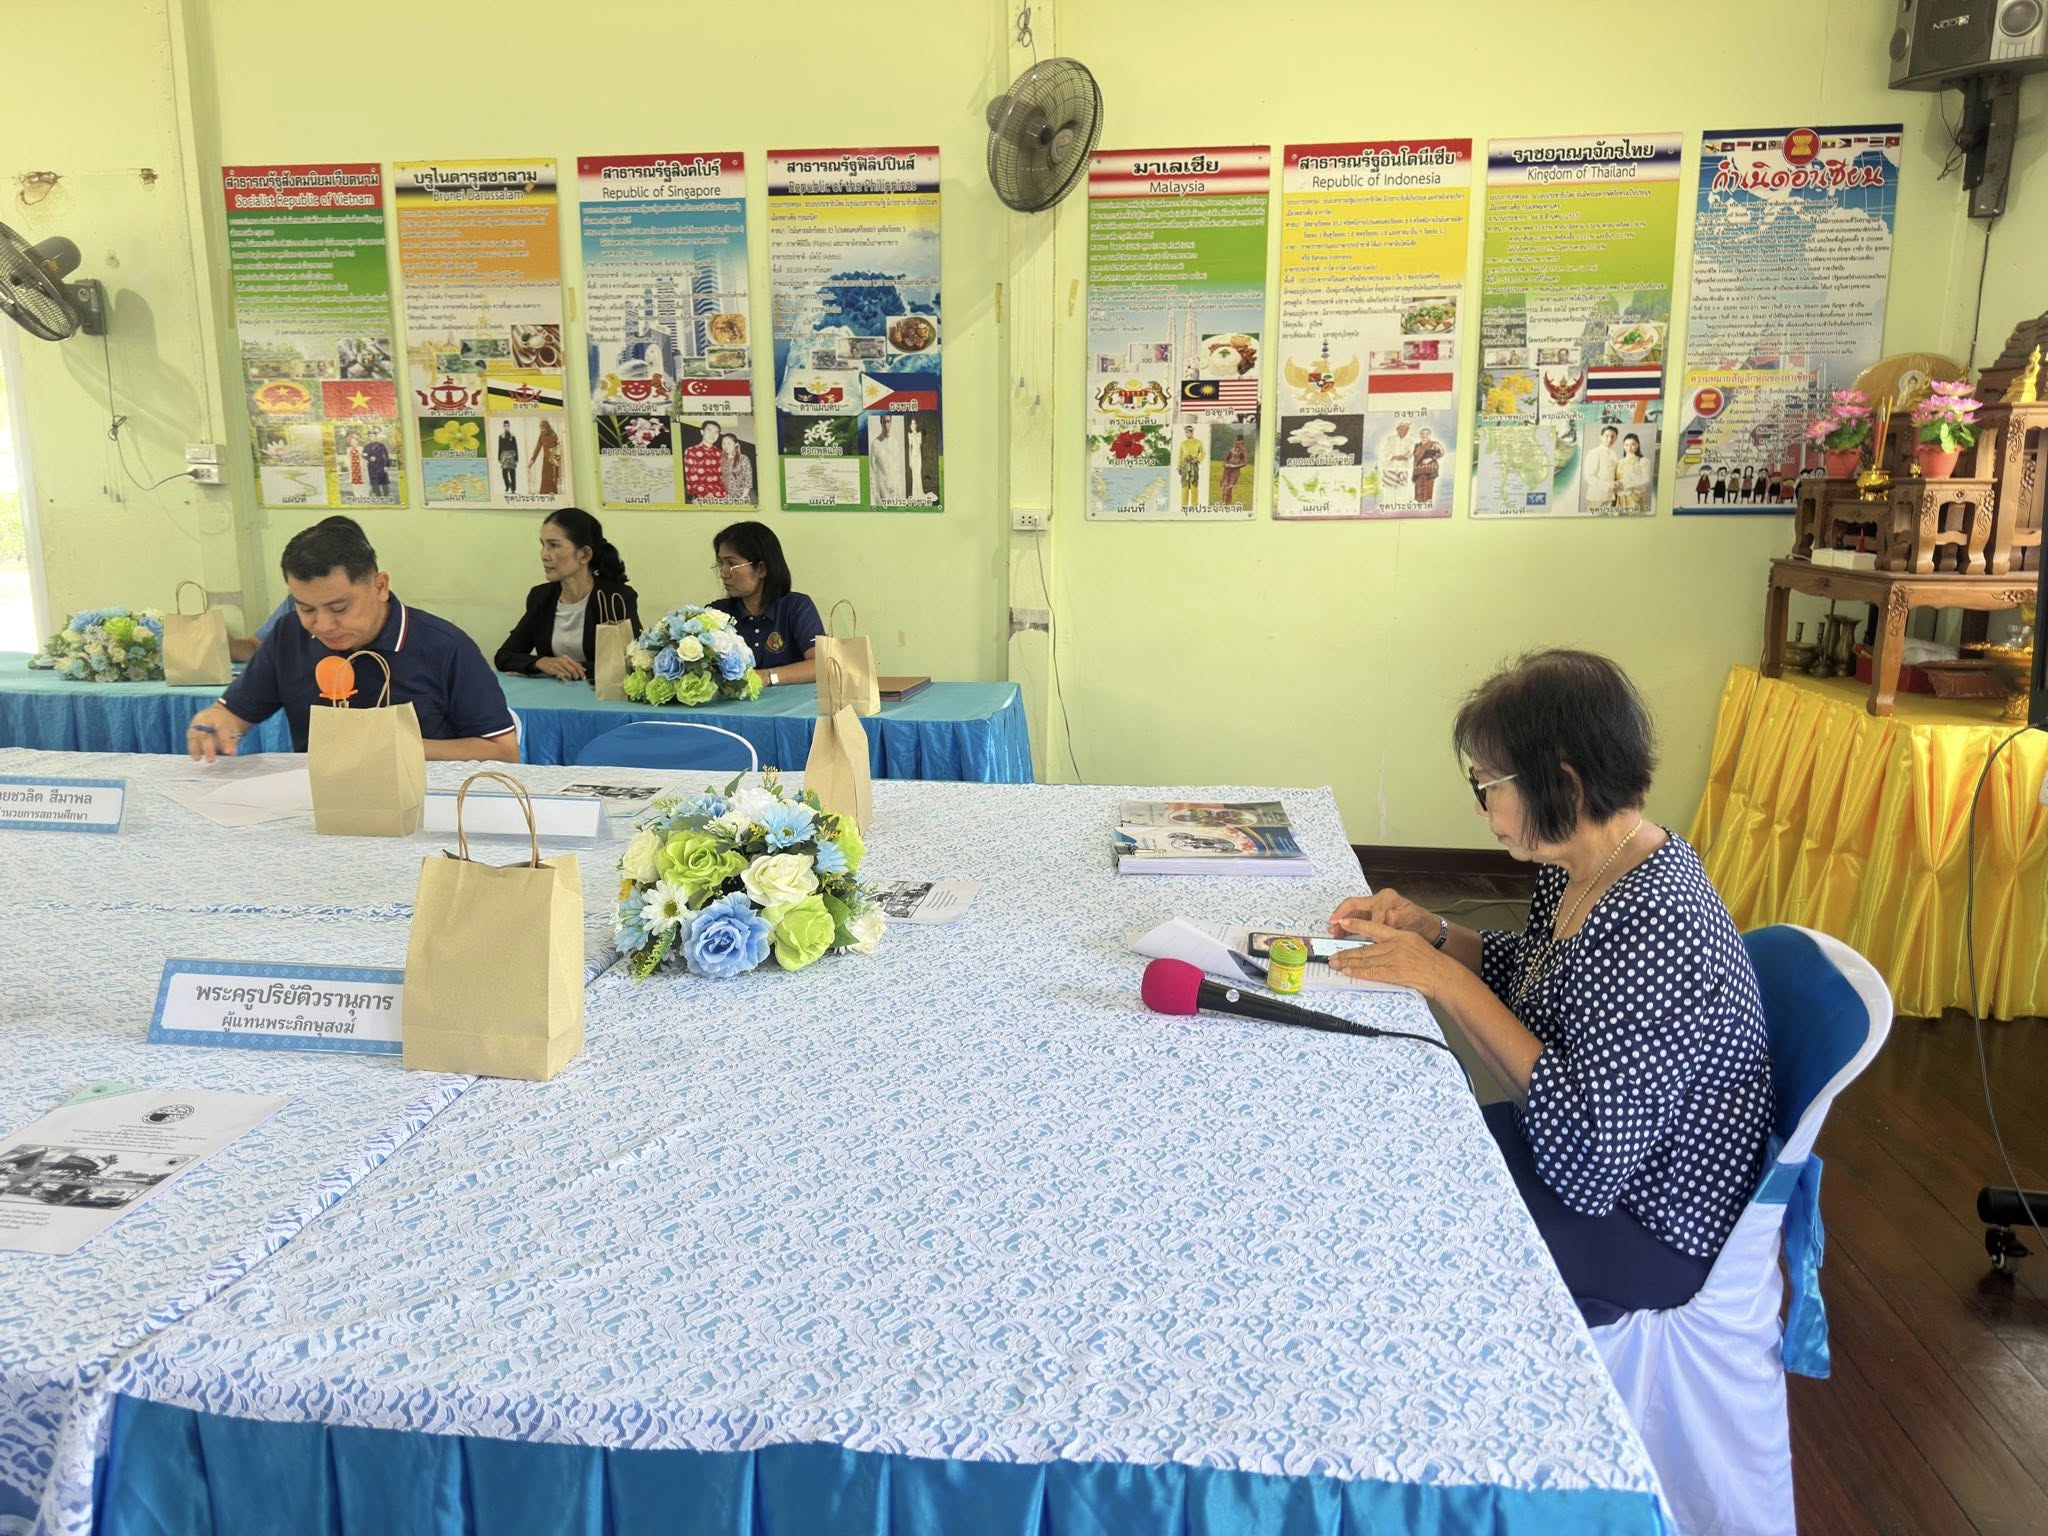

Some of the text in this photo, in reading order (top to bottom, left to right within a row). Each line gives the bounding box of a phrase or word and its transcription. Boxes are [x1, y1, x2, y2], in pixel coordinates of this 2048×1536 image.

[1513, 139, 1655, 163] ราชอาณาจักรไทย
[787, 155, 915, 176] สาธารณรัฐฟิลิปปินส์
[1133, 155, 1220, 175] มาเลเซีย
[1299, 147, 1456, 173] สาธารณรัฐอินโดนีเซีย
[603, 160, 721, 182] สาธารณรัฐสิงคโปร์
[1527, 163, 1636, 184] Kingdom of Thailand
[1713, 157, 1885, 193] กำเนิดอาเซียน
[226, 168, 379, 193] สาธารณรัฐสังคมนิยมเวียดนาม
[788, 178, 918, 195] Republic of the Philippines
[1149, 180, 1206, 196] Malaysia
[1312, 171, 1441, 190] Republic of Indonesia
[235, 191, 375, 209] Socialist Republic of Vietnam
[432, 187, 524, 202] Brunei Darussalam
[603, 185, 721, 200] Republic of Singapore
[702, 400, 732, 412] ธงชาติ
[799, 395, 841, 412] ตราแผ่นดิน
[888, 399, 919, 412] ธงชาติ
[1393, 407, 1429, 419] ธงชาติ
[625, 493, 651, 504] แผนที่
[808, 494, 837, 505] แผนที่
[1116, 501, 1146, 514] แผนที่
[1180, 501, 1243, 516] ชุดประจำชาติ
[1302, 502, 1330, 513] แผนที่
[49, 788, 93, 805] สีมาพล
[196, 983, 394, 1017] พระครูปริยัติวรานุการ
[222, 1011, 356, 1038] ผู้แทนพระภิกษุสงฆ์
